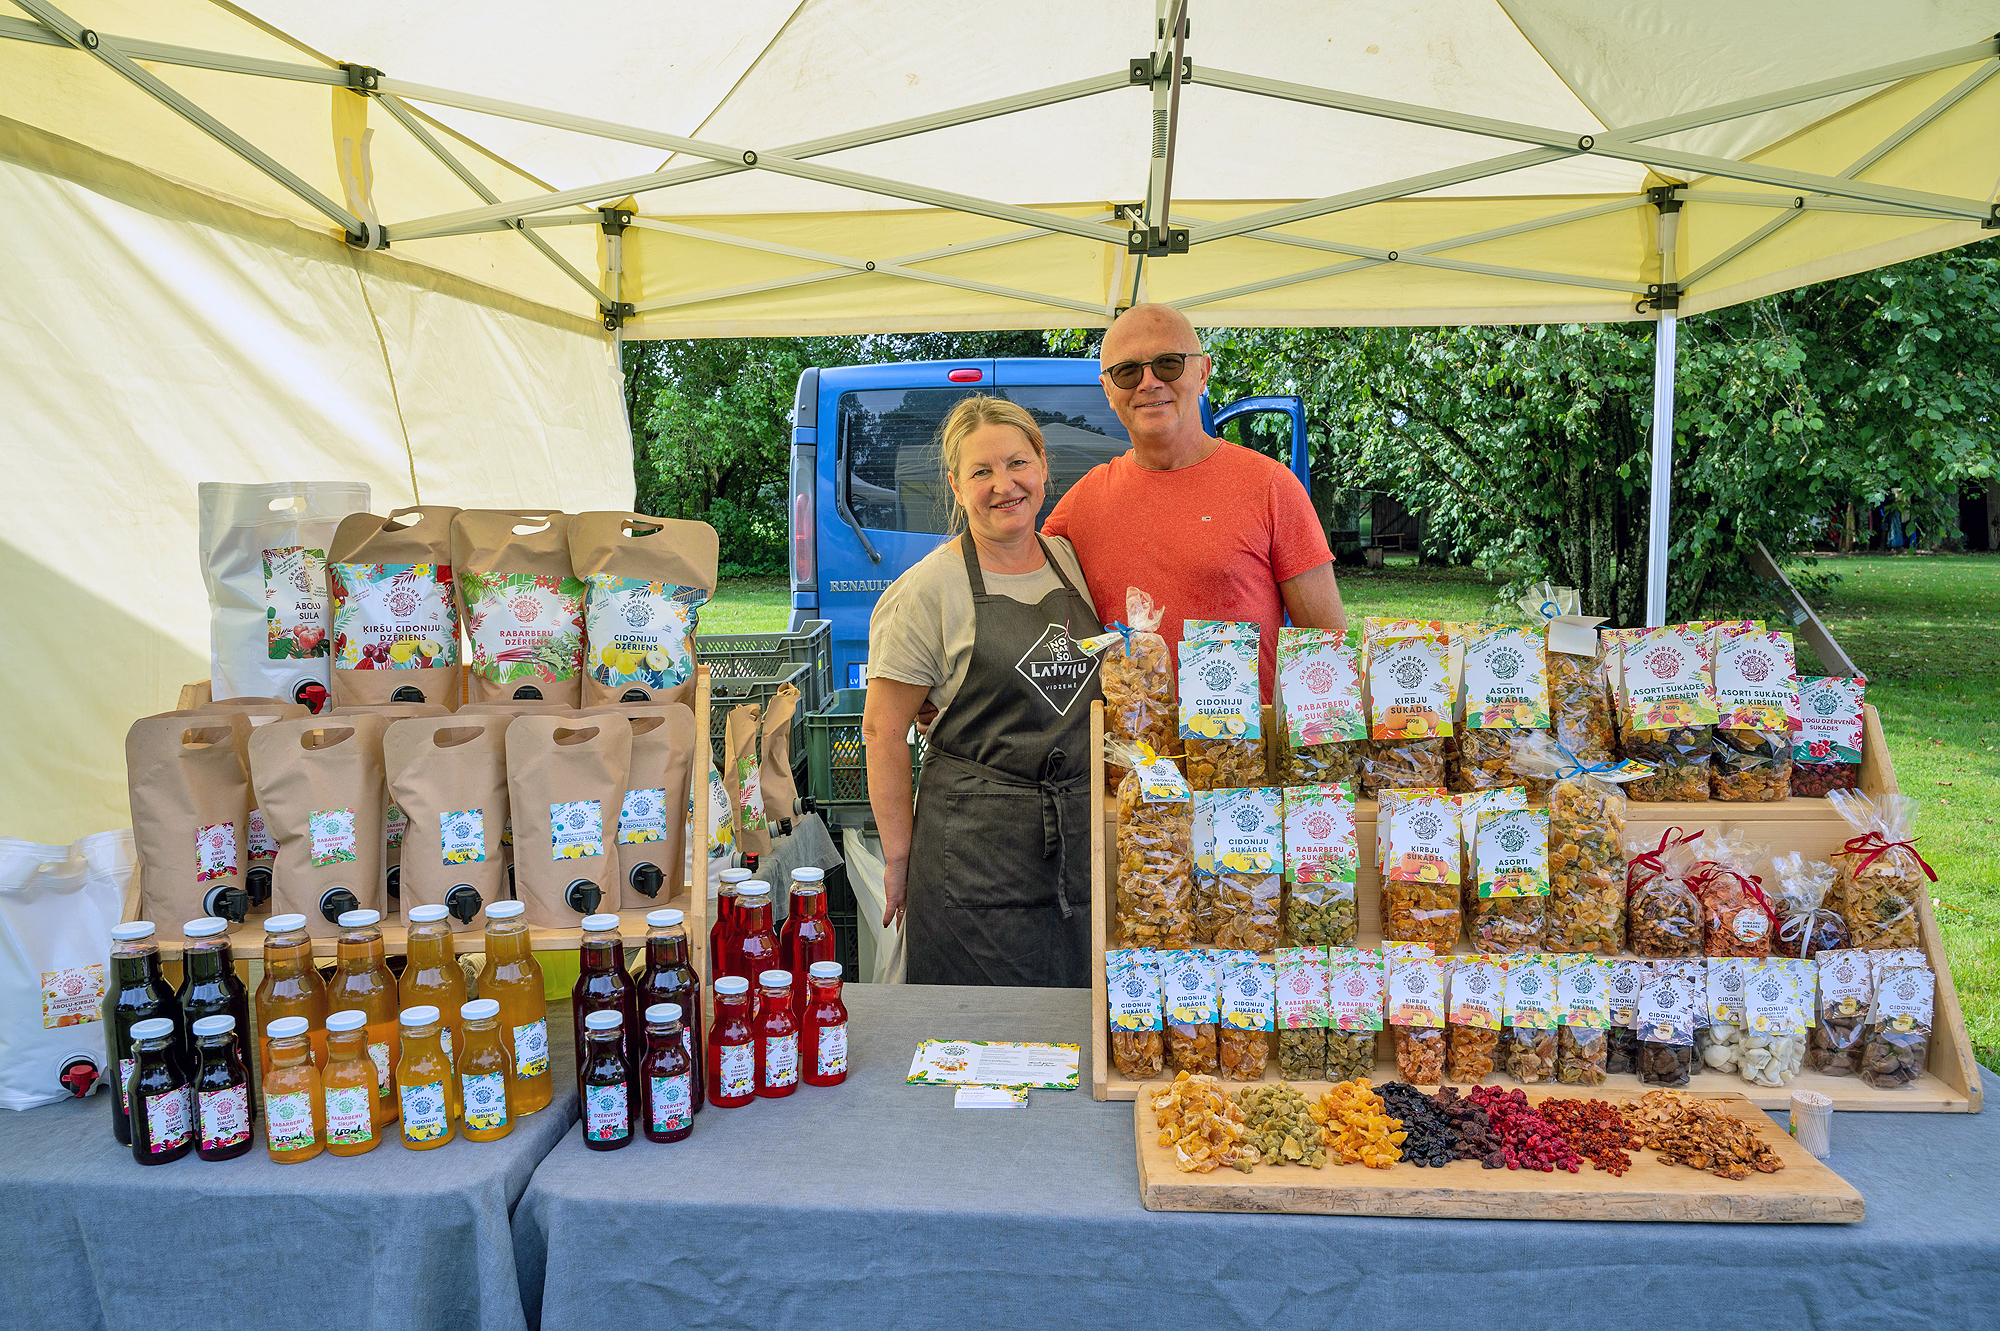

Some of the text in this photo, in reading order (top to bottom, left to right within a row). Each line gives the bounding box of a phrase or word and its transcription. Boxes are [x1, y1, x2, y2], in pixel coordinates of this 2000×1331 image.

[830, 580, 892, 592] RENAULT
[382, 586, 422, 603] GRANBERRY
[508, 594, 544, 610] GRANBERRY
[620, 600, 656, 616] GRANBERRY
[363, 624, 392, 635] ĶIRŠU
[380, 632, 426, 642] DZĒRIENS
[505, 637, 549, 646] DZĒRIENS
[614, 634, 658, 642] CIDONIJU
[1050, 637, 1066, 648] NO
[616, 641, 658, 651] DZĒRIENS
[1484, 646, 1526, 664] GRANBERRY
[1643, 646, 1686, 665] GRANBERRY
[1733, 648, 1775, 668] GRANBERRY
[1198, 659, 1238, 677] GRANBERRY
[1388, 655, 1429, 674] GRANBERRY
[1031, 662, 1086, 679] LATVIJU
[1299, 661, 1338, 680] GRANBERRY
[1633, 682, 1706, 695] ASORTI SUKĀDES
[1721, 689, 1752, 697] ASORTI
[1754, 688, 1793, 699] SUKĀDES
[1394, 696, 1427, 706] ĶIRBJU
[1485, 694, 1529, 704] SUKĀDES
[1808, 689, 1844, 704] GRANBERRY
[1297, 700, 1350, 712] RABARBERU
[1748, 697, 1783, 708] ĶIRŠIEM
[1198, 706, 1241, 715] SUKĀDES
[1390, 704, 1433, 714] SUKĀDES
[1304, 710, 1346, 720] SUKĀDES
[1231, 804, 1265, 818] GRANBERRY
[1301, 811, 1337, 826] GRANBERRY
[1408, 811, 1443, 827] GRANBERRY
[1495, 824, 1530, 840] GRANBERRY
[1230, 845, 1267, 853] SUKĀDES
[1411, 846, 1440, 855] ĶIRBJU
[1301, 853, 1339, 861] SUKĀDES
[1407, 852, 1444, 862] SUKĀDES
[1494, 866, 1532, 874] SUKĀDES
[1463, 1003, 1490, 1012] SUKĀDES
[525, 1052, 546, 1062] CIDONIJU
[272, 1119, 305, 1127] RABARBERU
[411, 1117, 439, 1125] CIDONIJU
